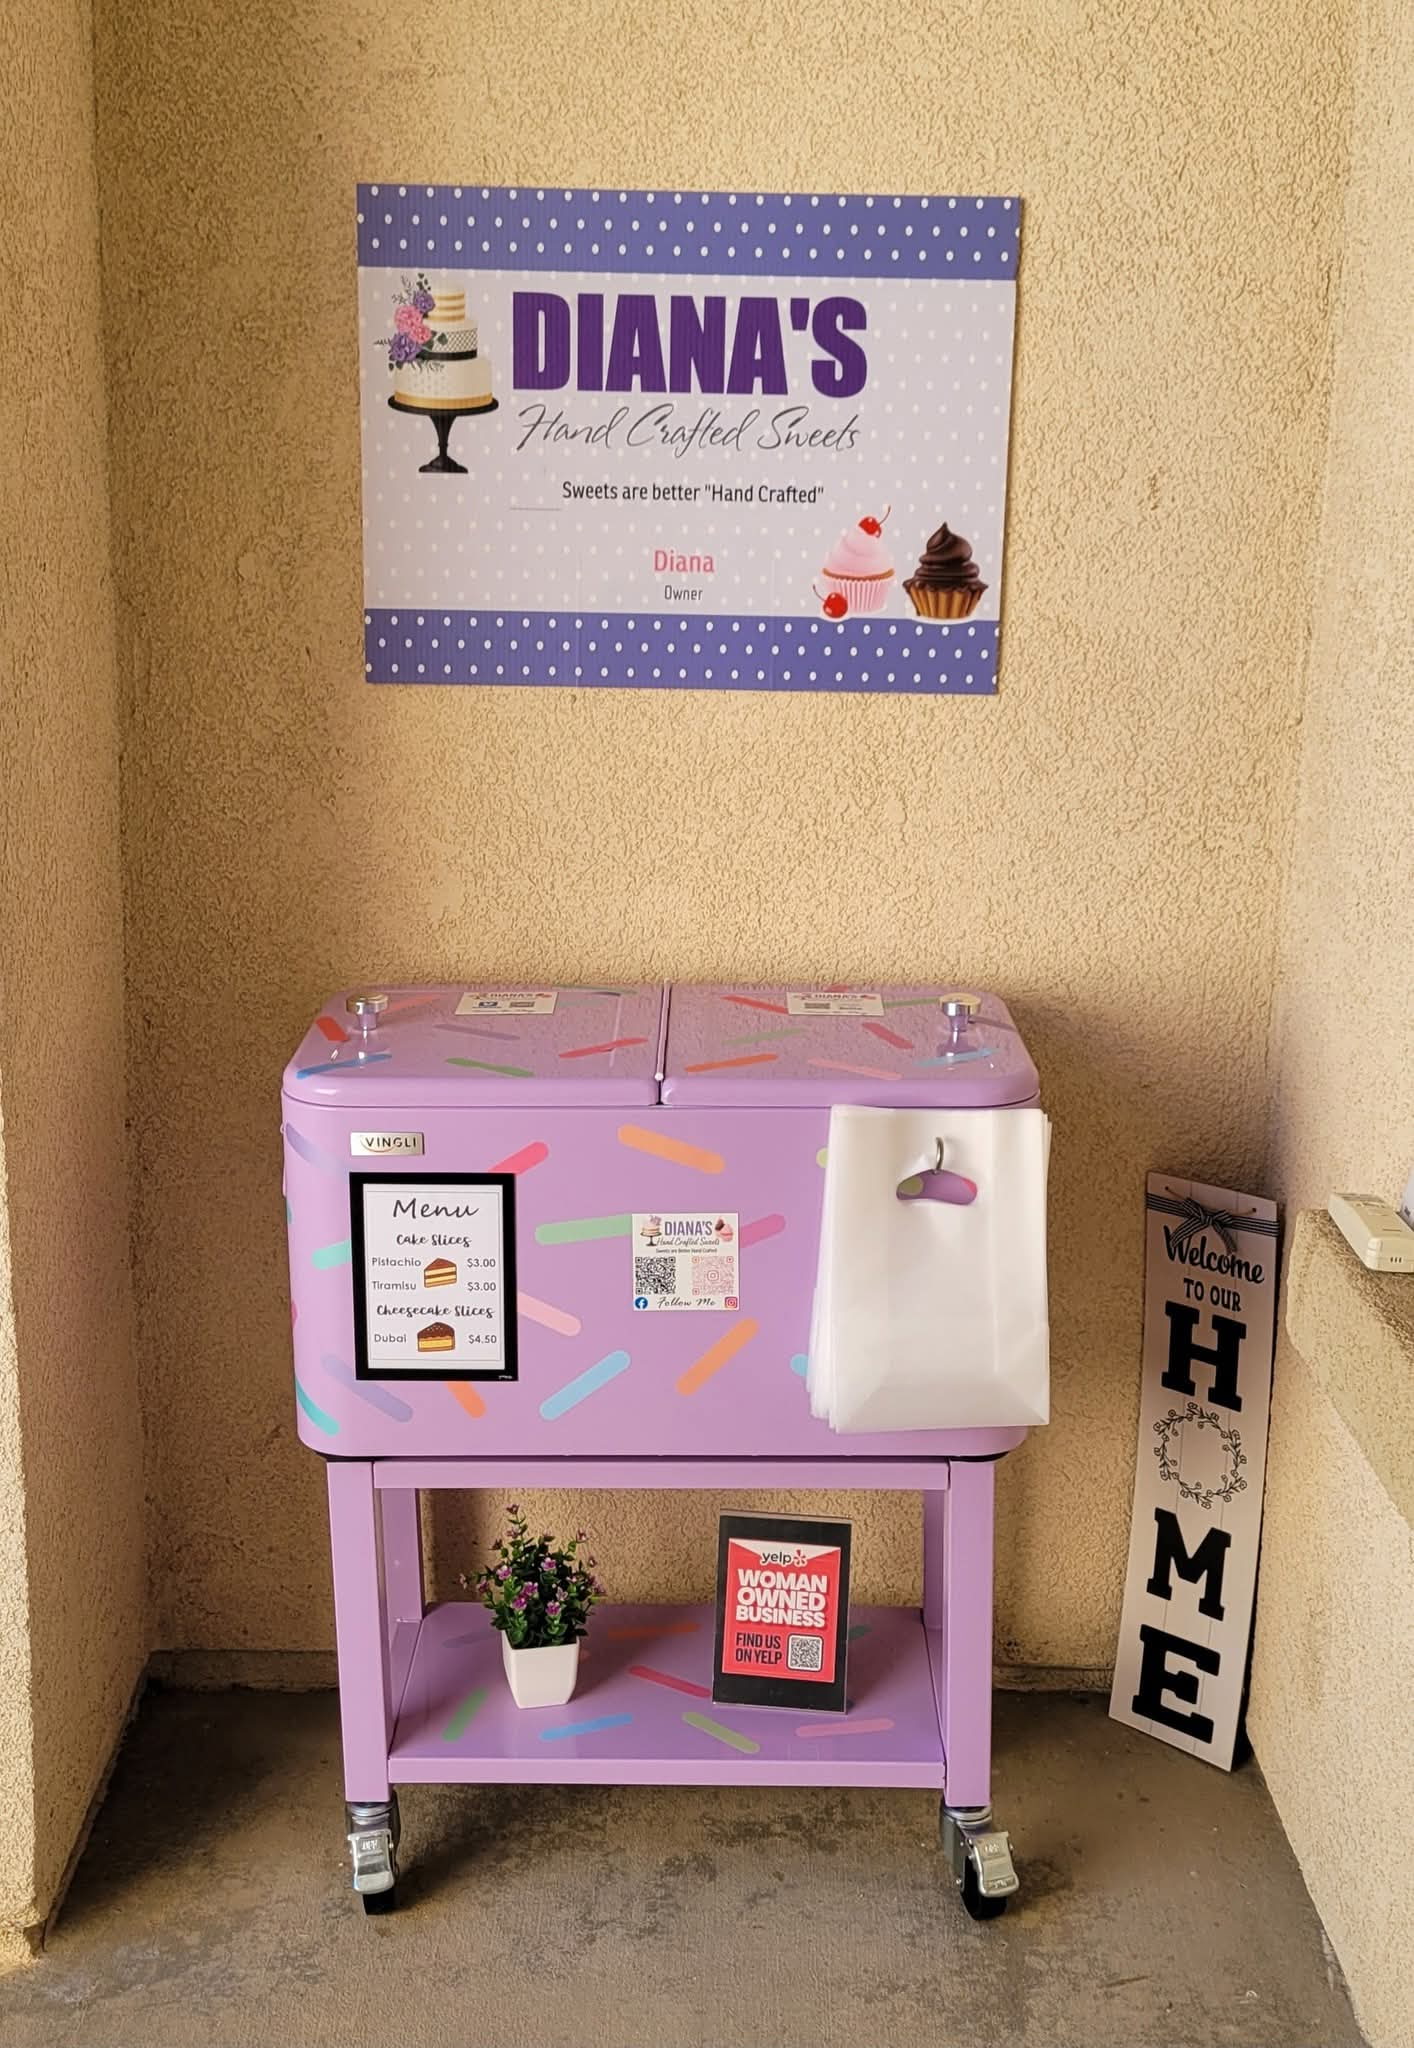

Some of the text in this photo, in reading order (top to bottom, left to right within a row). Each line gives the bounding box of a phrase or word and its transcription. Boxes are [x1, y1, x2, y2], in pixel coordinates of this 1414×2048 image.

[512, 291, 868, 398] DIANA'S
[516, 403, 862, 459] Hand Crafted Sweets
[562, 481, 825, 504] Sweets are better "Hand Crafted"
[653, 549, 715, 574] Diana
[664, 584, 703, 601] Owner
[365, 1137, 417, 1148] VINGLI
[392, 1198, 480, 1219] Menu
[664, 1220, 713, 1236] DIANA'S
[396, 1233, 472, 1248] Cake Slices
[371, 1257, 422, 1267] Pistachio
[467, 1257, 496, 1268] $3.00
[1163, 1225, 1265, 1284] Welcome
[371, 1281, 417, 1290] Tiramisu
[467, 1282, 497, 1292] $3.00
[657, 1296, 716, 1308] Follow Me
[1183, 1277, 1241, 1312] TO OUR
[376, 1304, 495, 1318] Cheesecake Slices
[374, 1333, 407, 1343] Dubai
[468, 1334, 497, 1344] $4.50
[761, 1551, 792, 1565] yelp
[737, 1568, 828, 1593] WOMAN
[736, 1586, 826, 1611] OWNED
[735, 1605, 826, 1628] BUSINESS
[736, 1632, 781, 1649] FIND US
[735, 1648, 782, 1665] ON YELP
